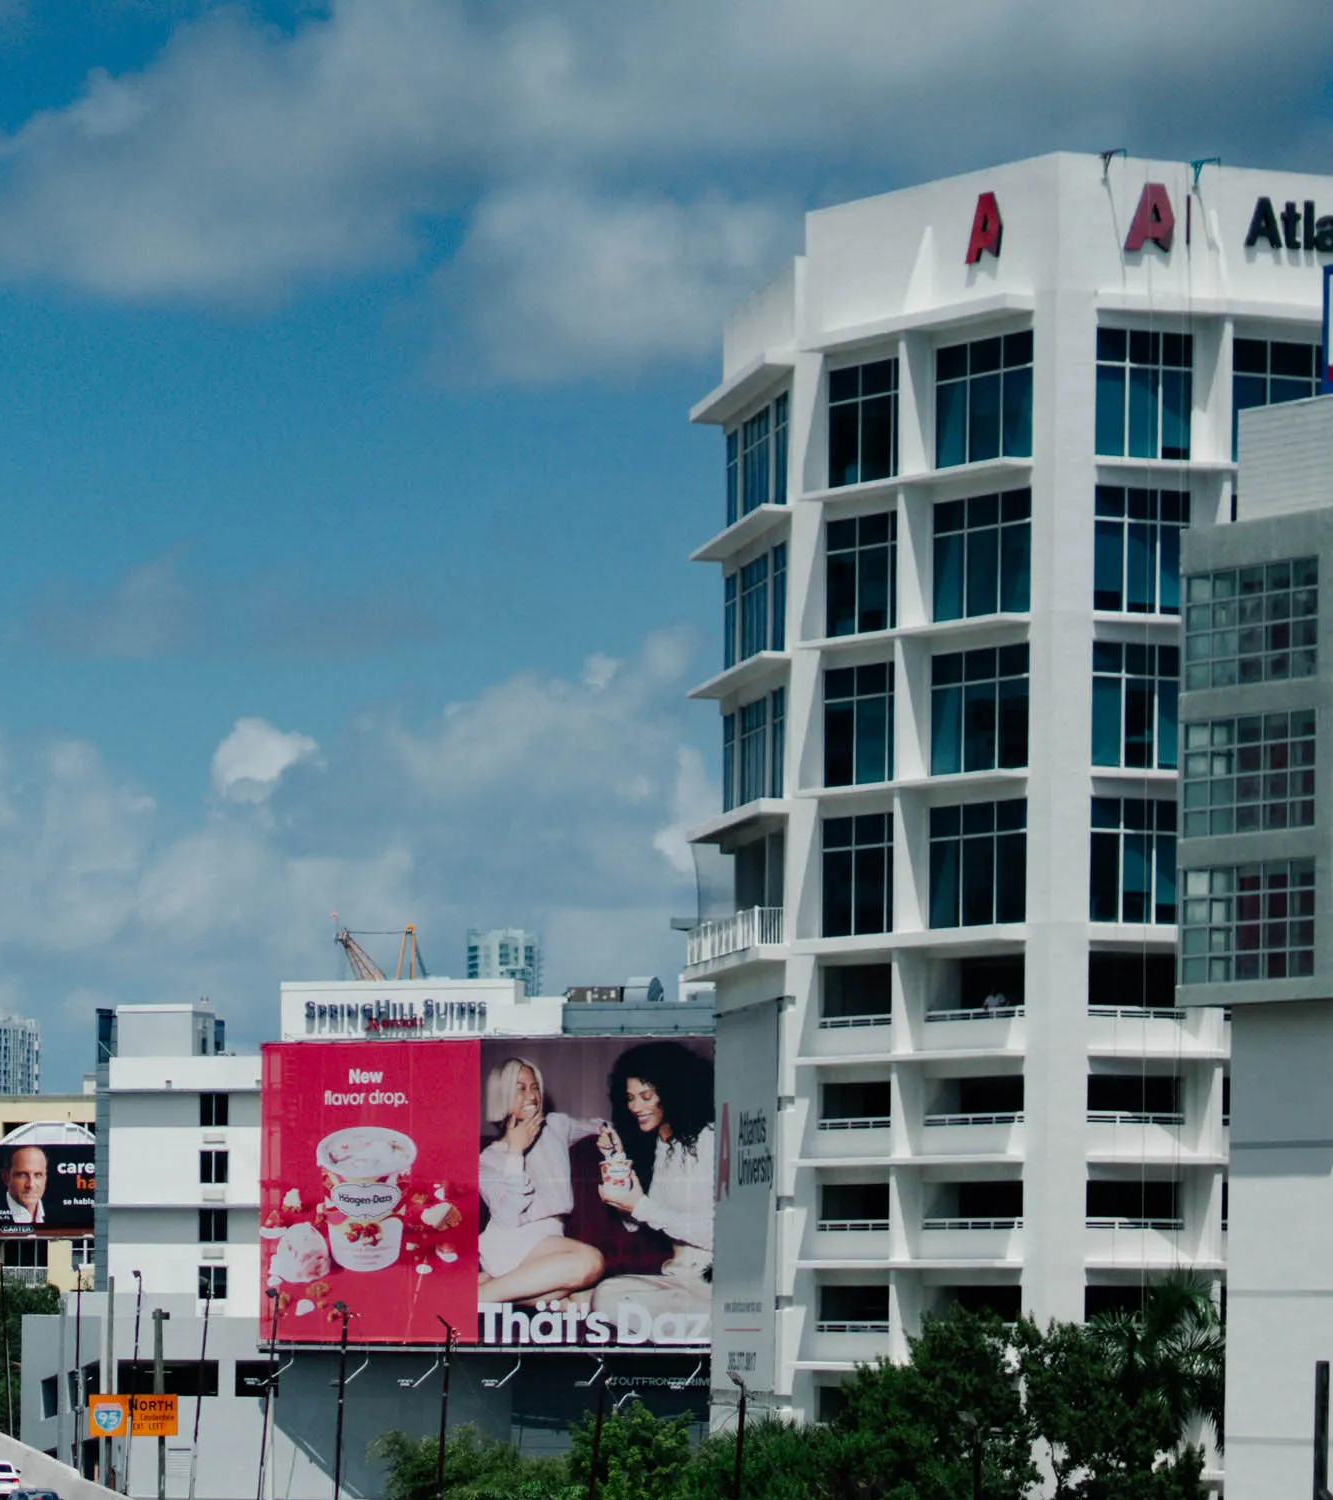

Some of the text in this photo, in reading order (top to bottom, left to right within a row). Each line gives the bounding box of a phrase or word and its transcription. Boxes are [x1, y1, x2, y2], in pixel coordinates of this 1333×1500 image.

[423, 999, 487, 1018] SUITES
[348, 1068, 383, 1084] New
[324, 1089, 408, 1107] flavor drop.
[738, 1108, 766, 1147] Atlantis
[738, 1147, 773, 1189] University
[478, 1300, 711, 1345] Thät's Daz
[129, 1400, 173, 1411] NORTH
[98, 1412, 119, 1426] 95
[148, 1423, 164, 1431] LEFT
